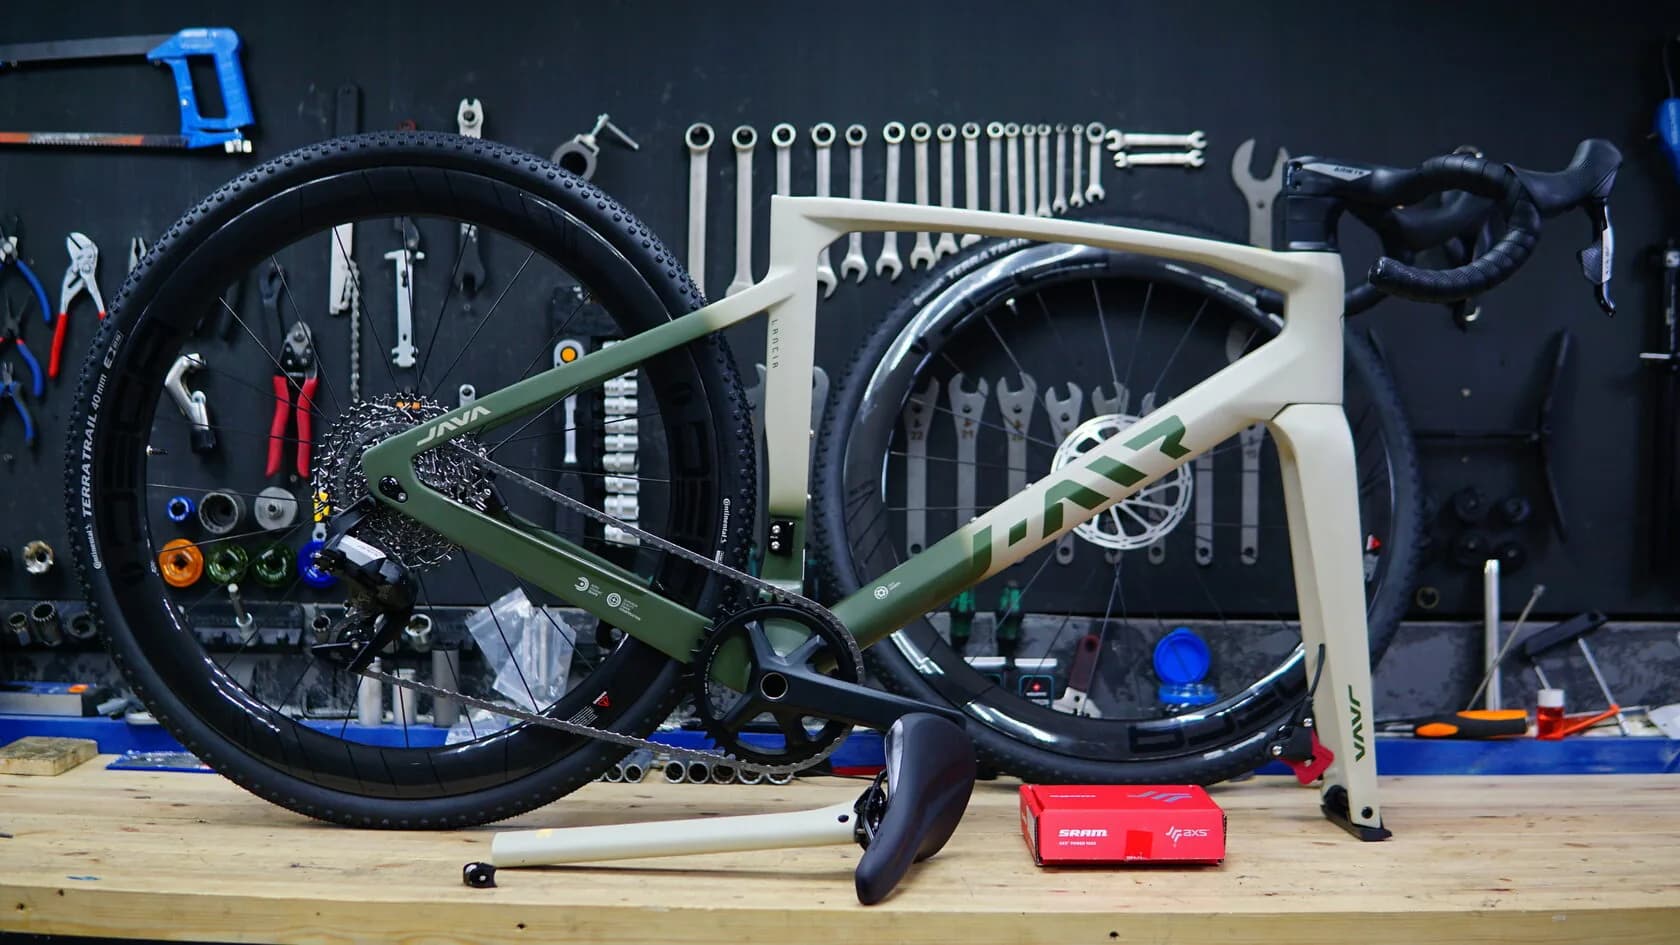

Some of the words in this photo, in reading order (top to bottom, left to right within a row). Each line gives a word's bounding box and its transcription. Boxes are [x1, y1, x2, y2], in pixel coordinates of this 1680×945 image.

[91, 394, 101, 412] 40
[97, 373, 107, 395] mm
[82, 411, 98, 462] TRAIL
[416, 405, 491, 447] JAVA
[82, 463, 93, 518] TERRA
[1348, 684, 1366, 762] JAVA
[1058, 829, 1107, 838] SRAM
